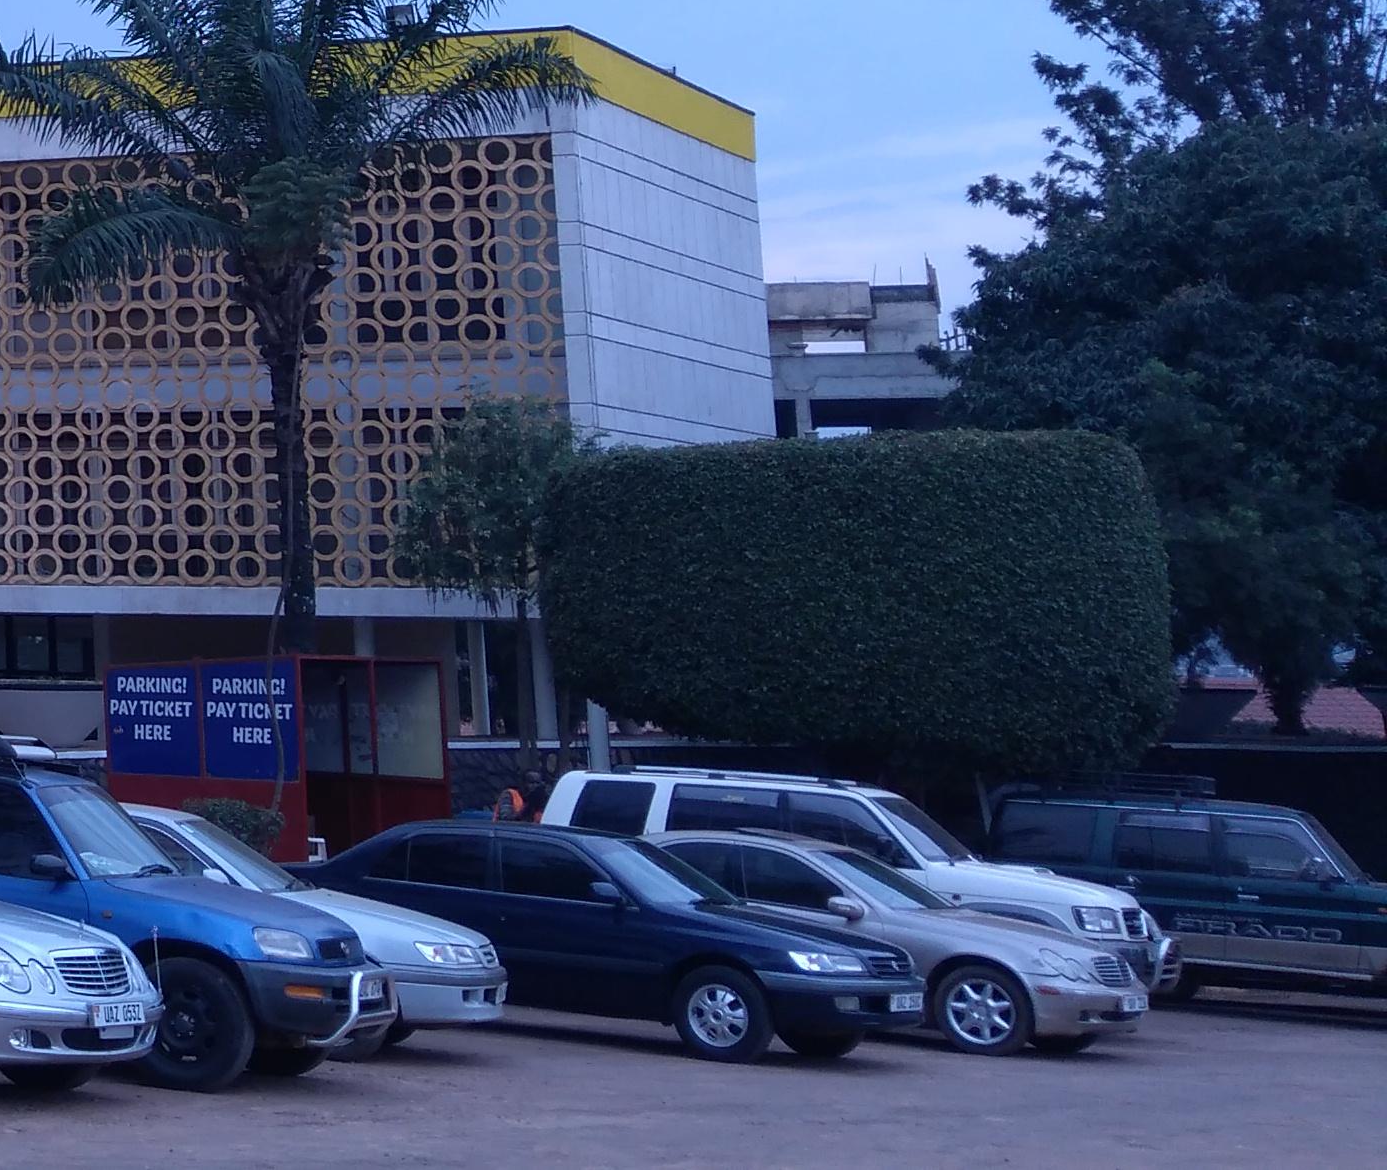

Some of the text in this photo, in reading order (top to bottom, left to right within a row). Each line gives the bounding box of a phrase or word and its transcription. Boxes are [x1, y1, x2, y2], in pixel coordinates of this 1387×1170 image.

[116, 676, 187, 694] PARKING!
[212, 678, 285, 696] PARKING!
[109, 699, 193, 718] PAY TICKET
[206, 701, 236, 718] PAY
[133, 724, 172, 741] HERE
[232, 726, 272, 744] HERE
[1172, 917, 1343, 943] PRADO
[103, 1005, 120, 1023] UAZ
